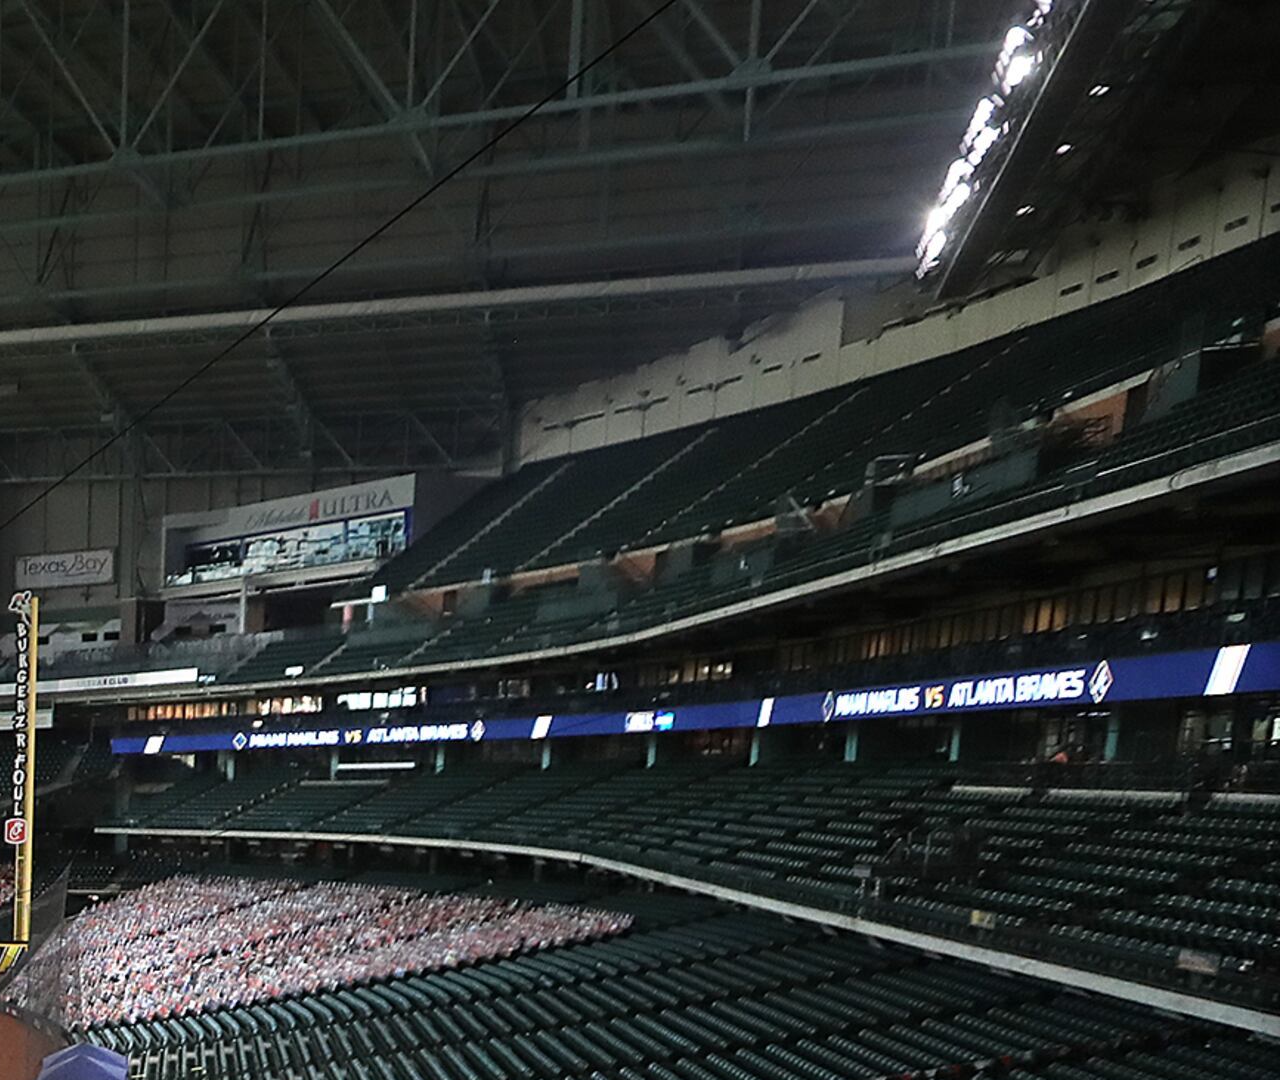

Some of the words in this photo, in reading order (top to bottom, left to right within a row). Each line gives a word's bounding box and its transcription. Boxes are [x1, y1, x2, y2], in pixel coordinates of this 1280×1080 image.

[322, 488, 394, 517] ULTRA
[22, 557, 67, 576] Texas
[72, 555, 108, 577] Bay
[925, 684, 945, 709] VS
[947, 677, 1014, 708] ATLANTA
[1014, 669, 1087, 703] BRAVES
[344, 730, 362, 744] VS
[12, 751, 27, 818] FOUL
